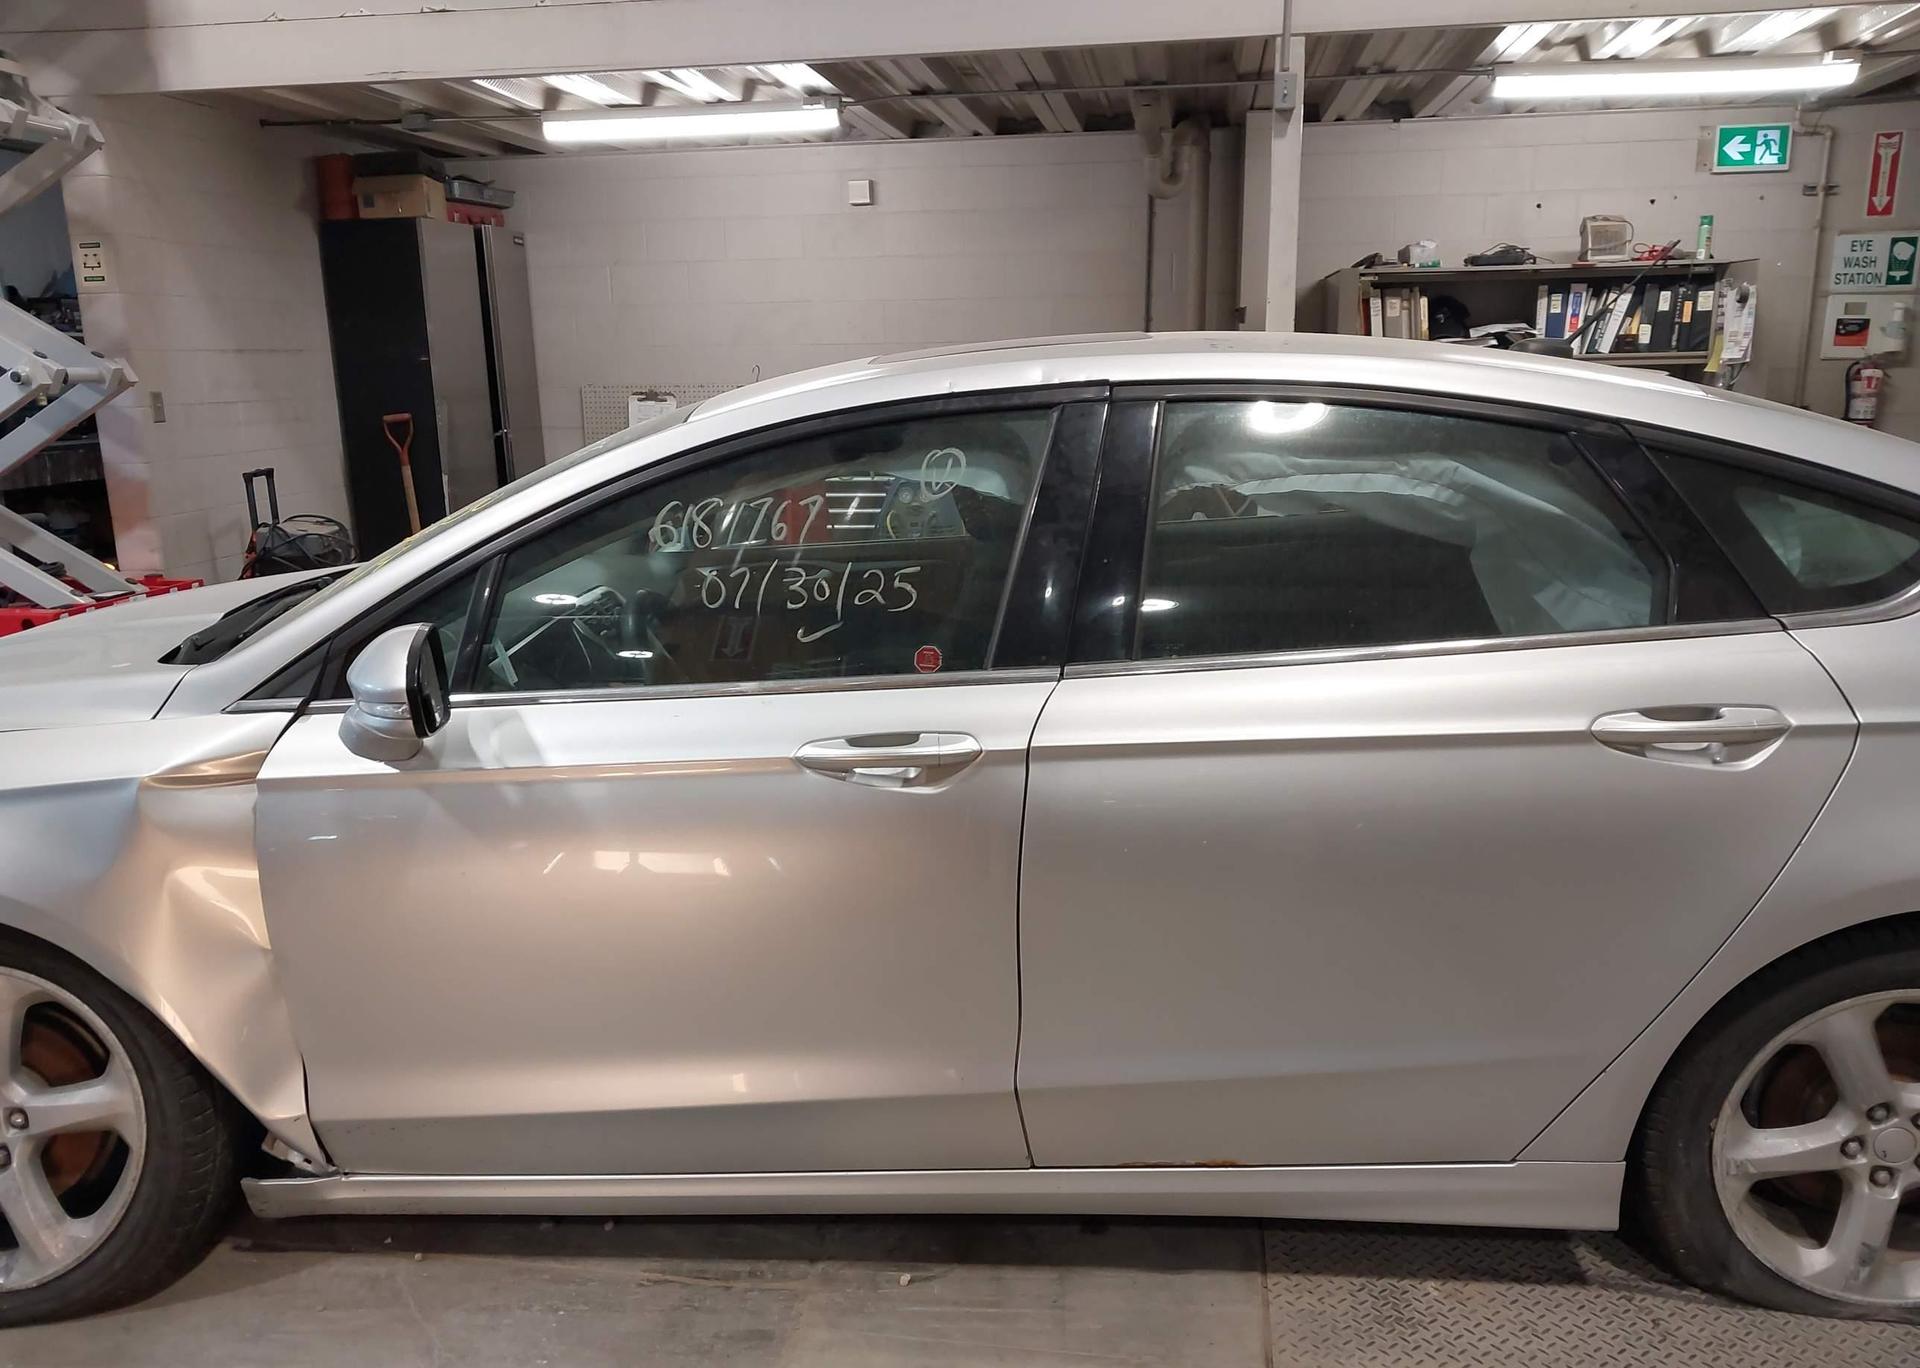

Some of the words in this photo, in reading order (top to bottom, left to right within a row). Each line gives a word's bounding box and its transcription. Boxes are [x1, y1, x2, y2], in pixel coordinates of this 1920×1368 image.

[1850, 239, 1874, 253] EYE
[1843, 256, 1878, 269] WASH
[1833, 271, 1884, 286] STATION
[699, 558, 922, 622] 07/30/25
